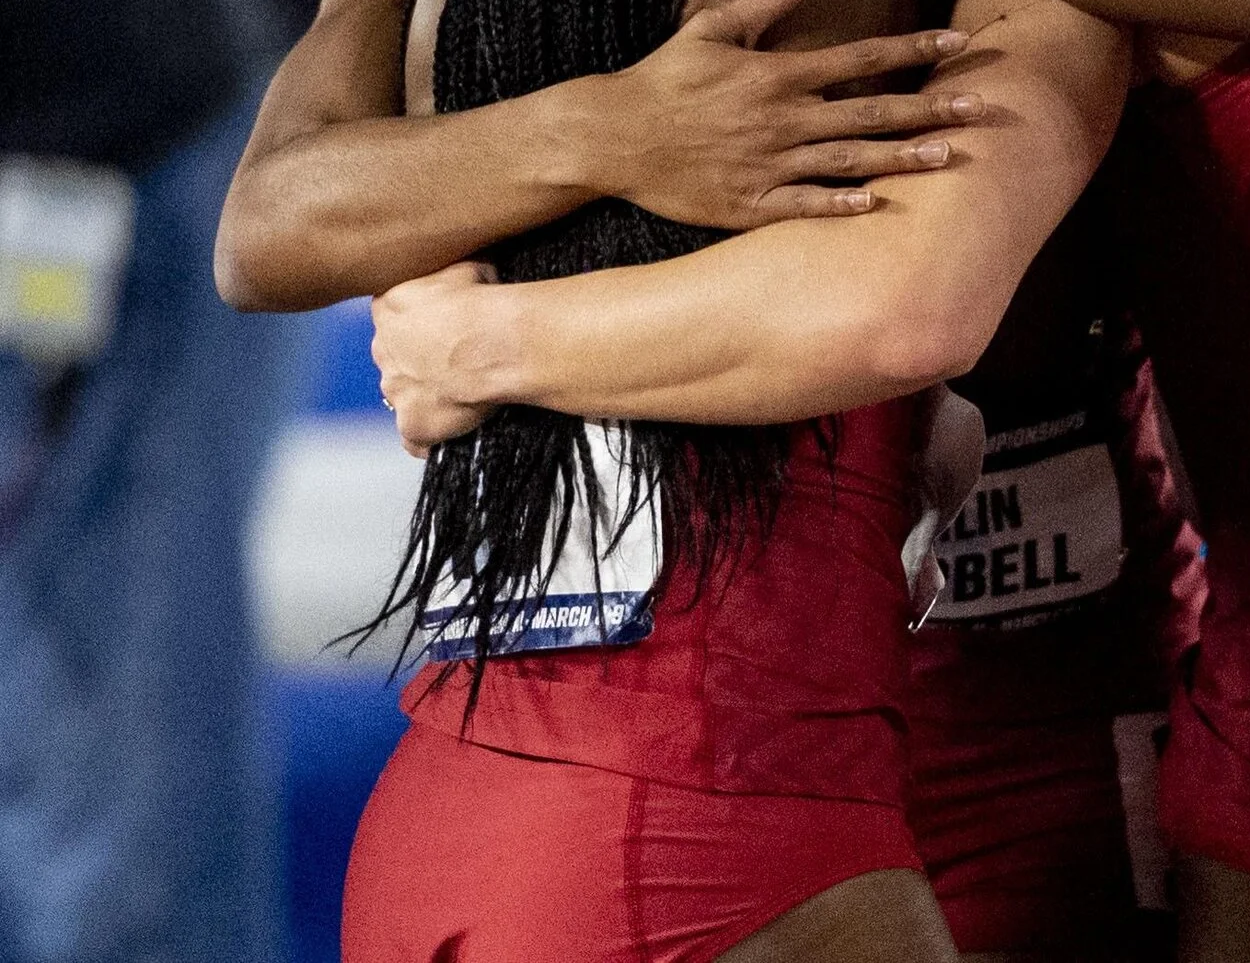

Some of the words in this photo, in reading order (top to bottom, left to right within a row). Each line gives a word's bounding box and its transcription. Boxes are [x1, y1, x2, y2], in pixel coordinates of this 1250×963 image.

[940, 485, 1022, 541] LIN
[938, 533, 1080, 602] BELL
[531, 605, 592, 629] MARCH
